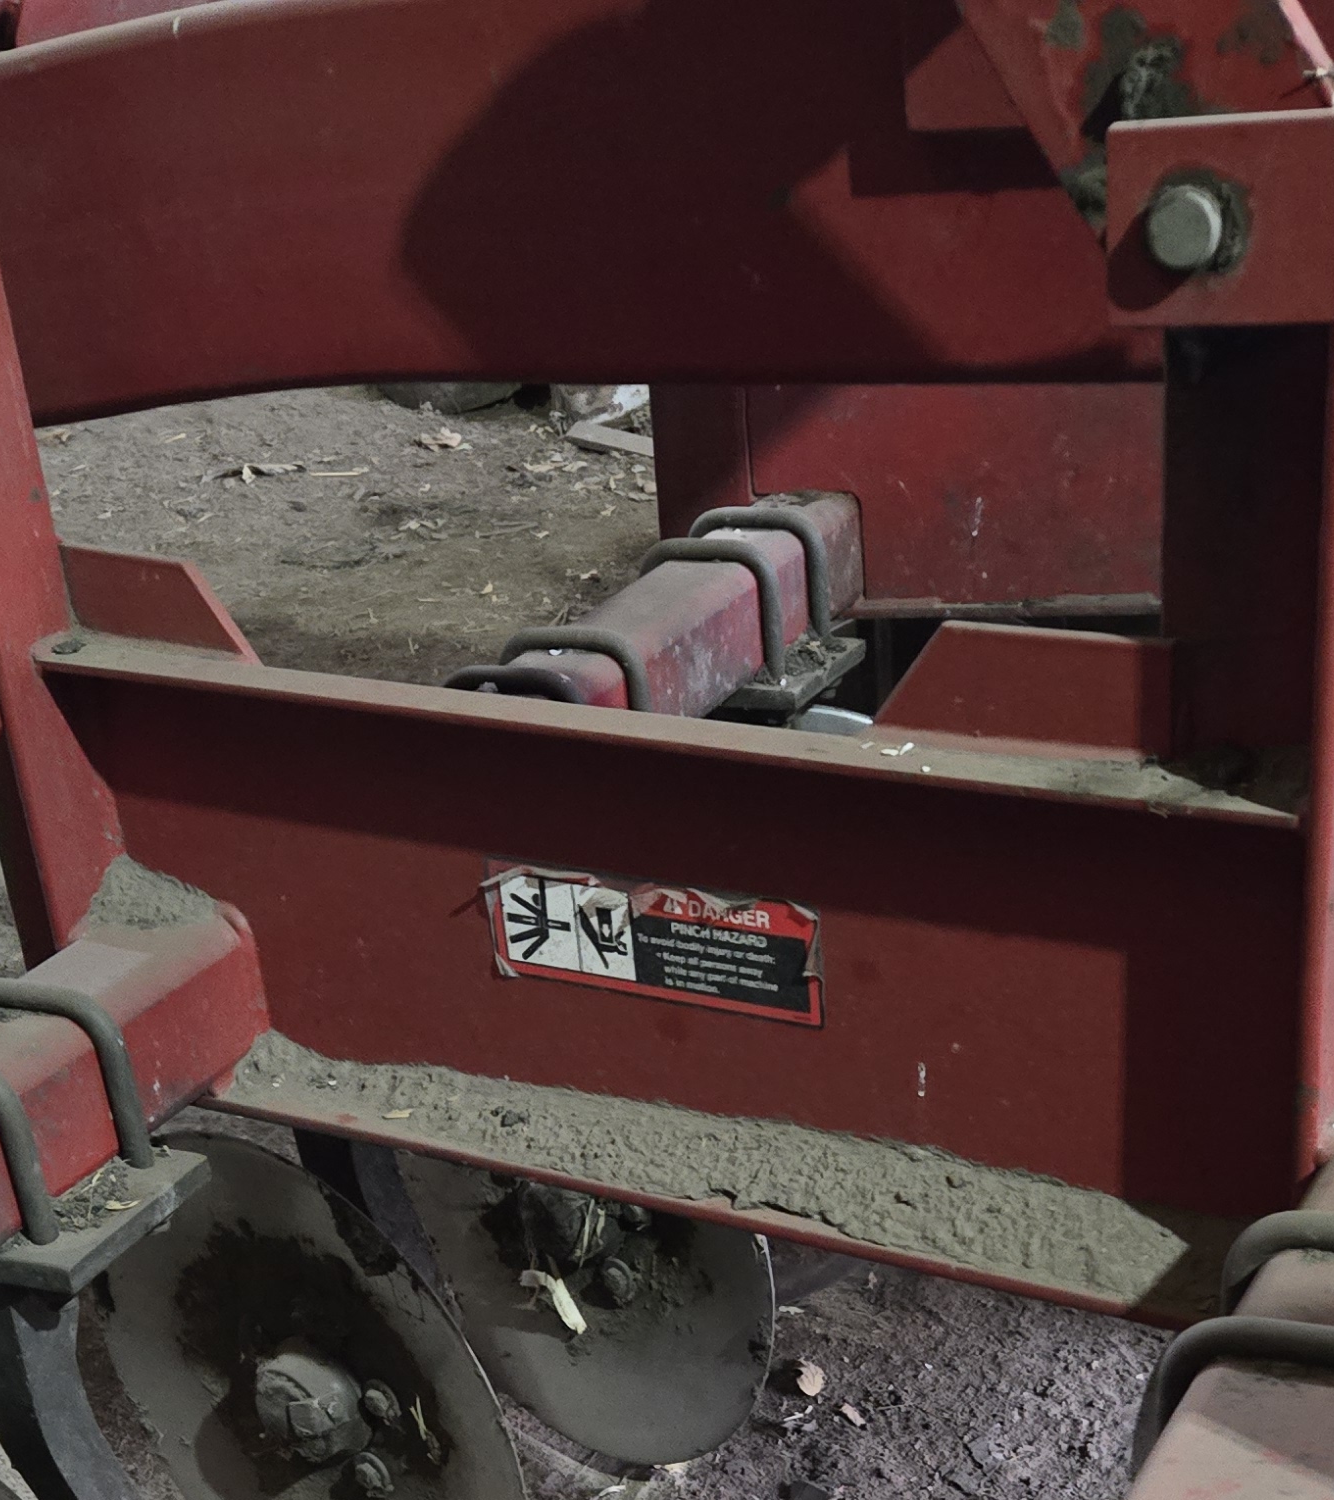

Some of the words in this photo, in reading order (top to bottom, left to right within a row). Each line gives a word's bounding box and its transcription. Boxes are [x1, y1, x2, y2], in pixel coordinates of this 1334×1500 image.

[688, 899, 771, 929] DANGER
[636, 933, 649, 944] To
[650, 936, 675, 948] avoid
[675, 940, 706, 954] bodily
[706, 946, 733, 959] injury
[733, 950, 745, 958] or
[670, 922, 711, 940] PINCH
[712, 930, 768, 948] HAZARD
[662, 951, 687, 965] Keep
[687, 957, 700, 965] all
[700, 960, 738, 972] persons
[738, 966, 764, 979] away
[664, 964, 688, 977] while
[688, 969, 706, 980] any
[707, 972, 725, 984] part
[726, 975, 738, 985] of
[739, 978, 780, 993] machine
[664, 977, 675, 987] is
[675, 979, 685, 988] in
[686, 981, 721, 994] motion.
